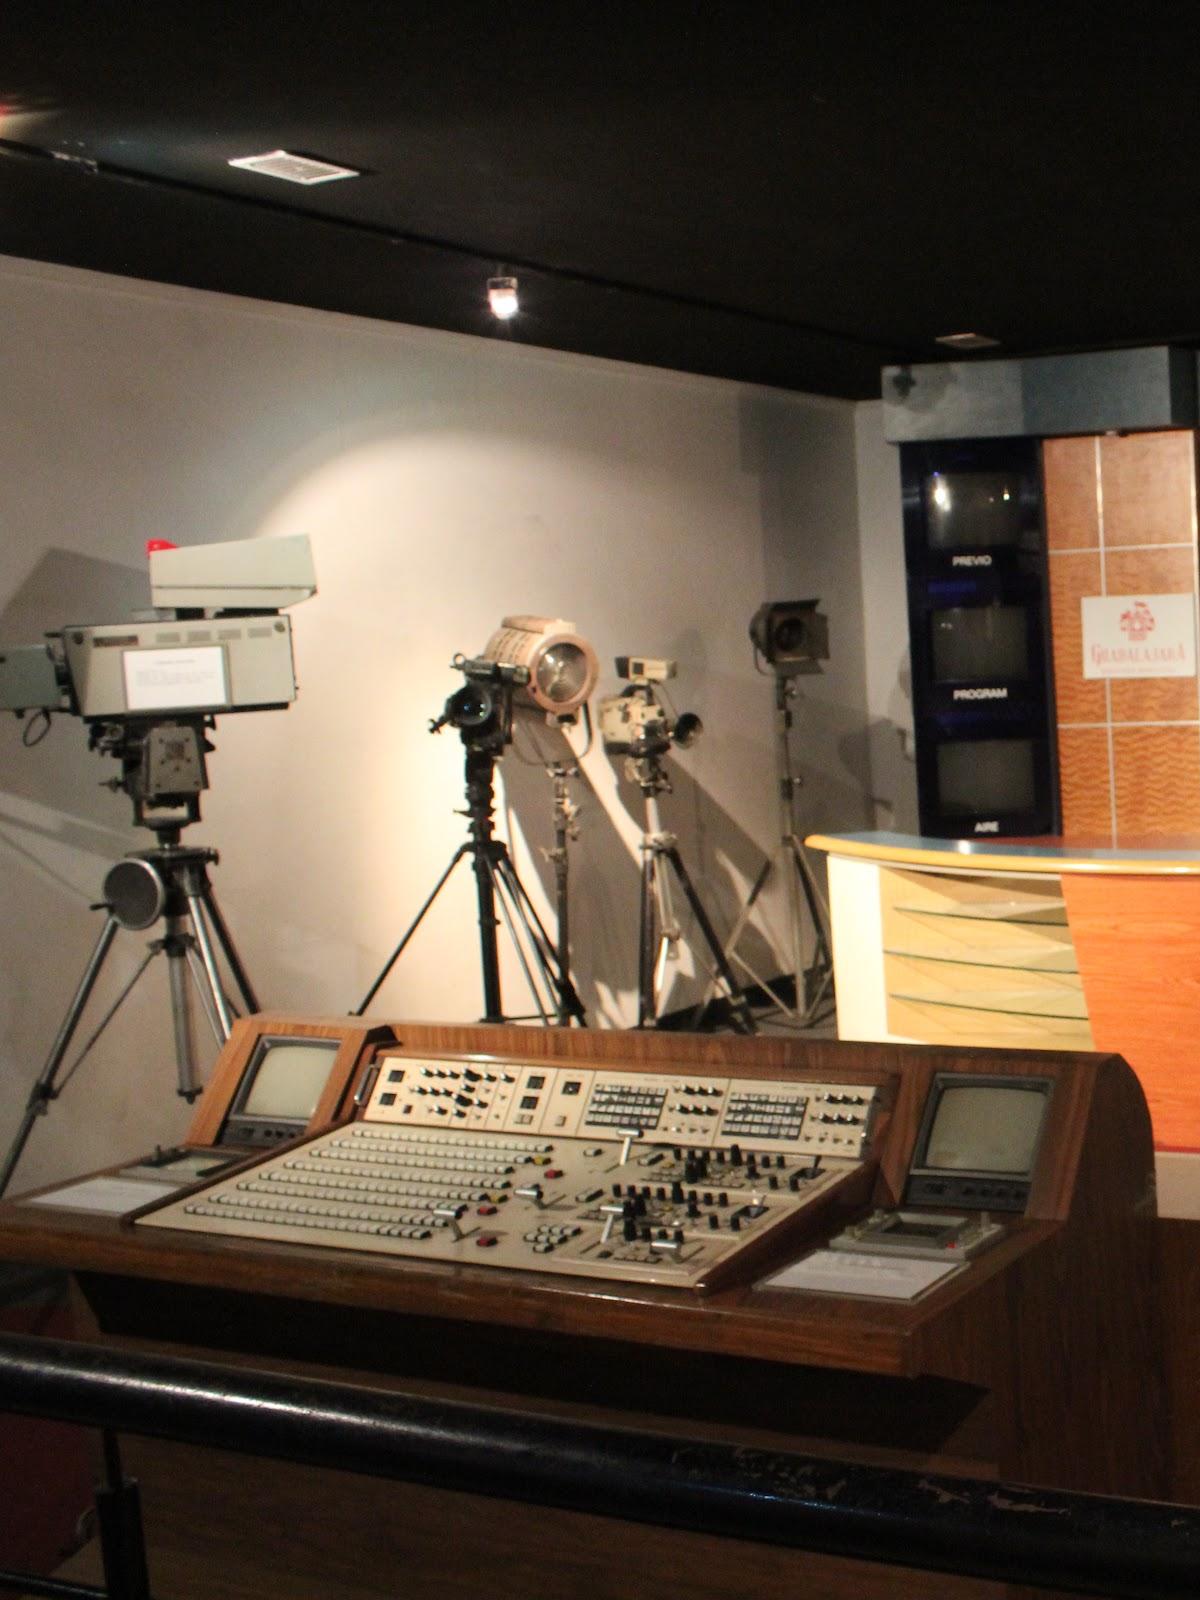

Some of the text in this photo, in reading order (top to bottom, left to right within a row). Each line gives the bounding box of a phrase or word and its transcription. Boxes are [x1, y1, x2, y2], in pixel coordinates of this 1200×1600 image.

[951, 553, 993, 568] PREVIO
[952, 687, 1008, 701] PROGRAM
[973, 820, 1000, 833] AIRE
